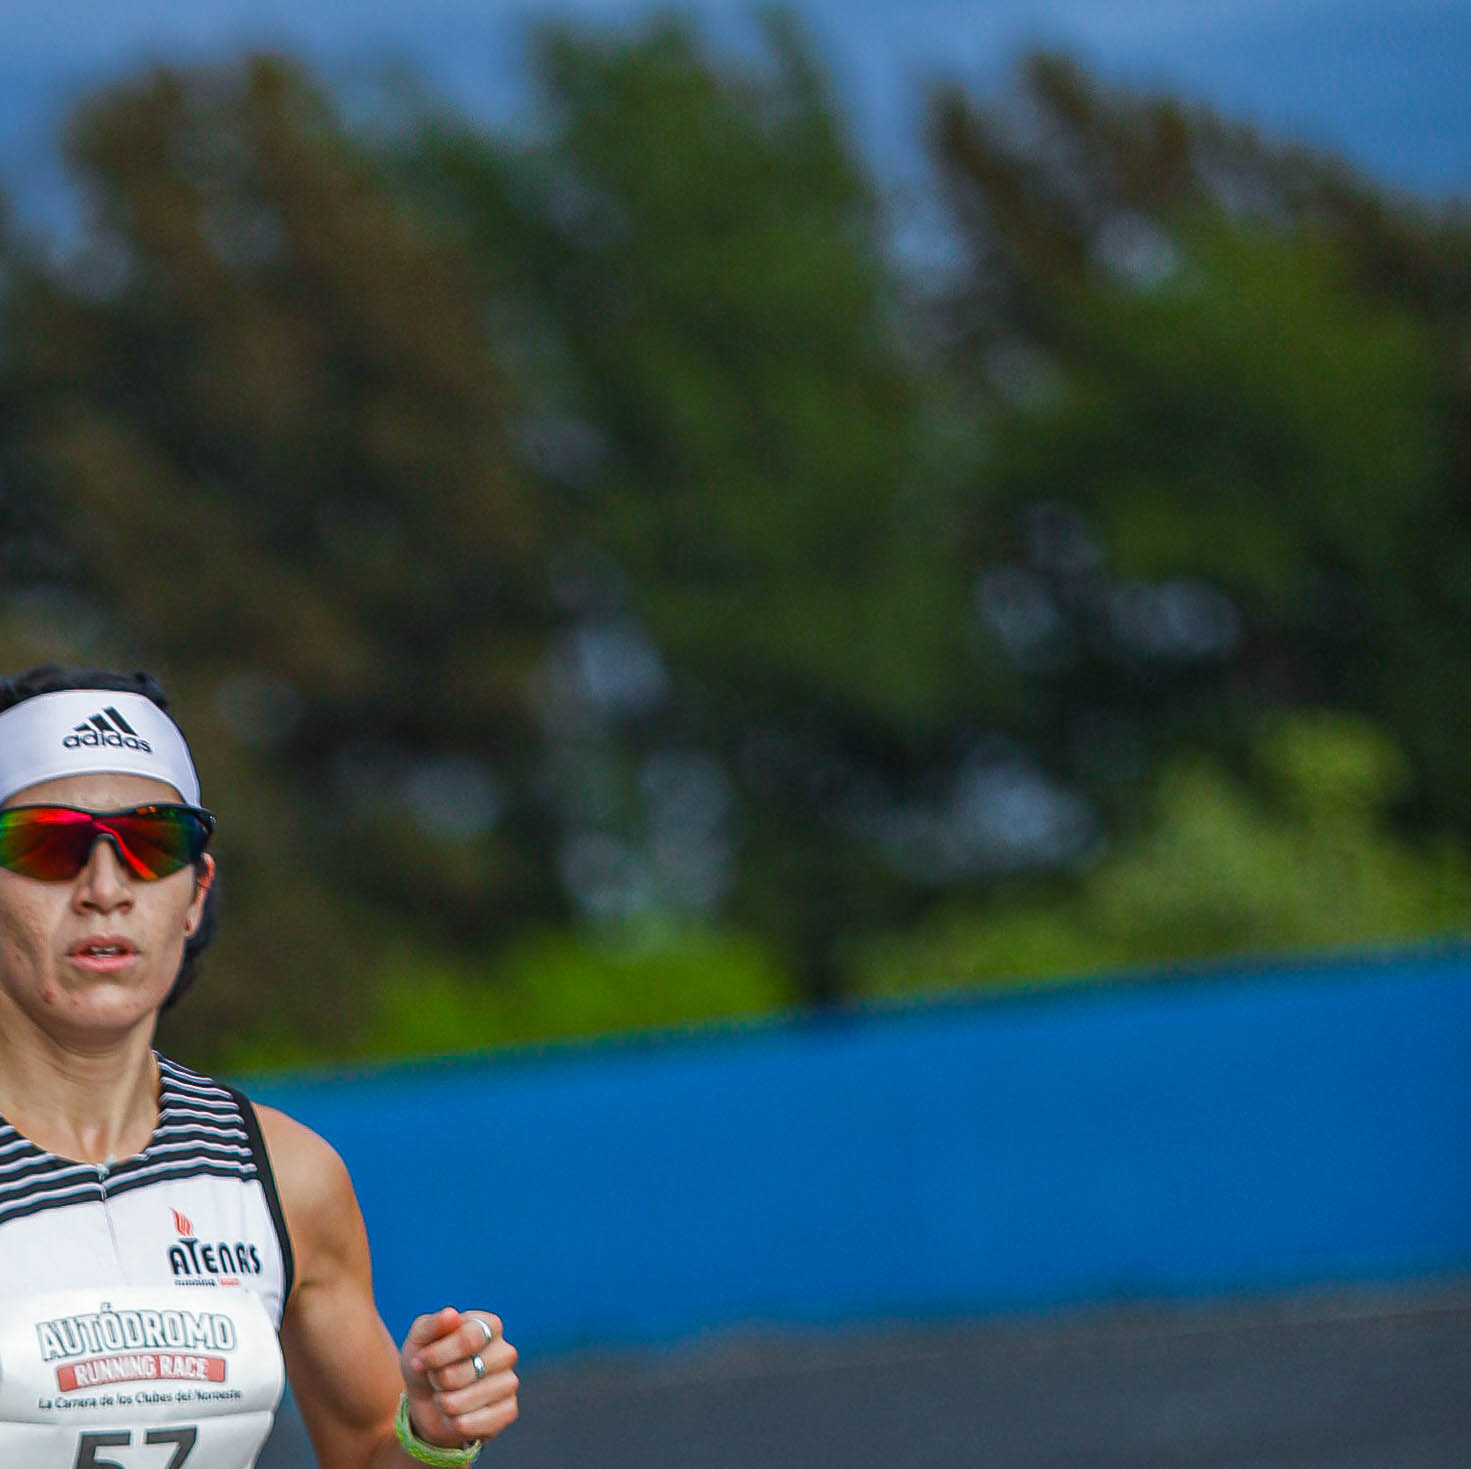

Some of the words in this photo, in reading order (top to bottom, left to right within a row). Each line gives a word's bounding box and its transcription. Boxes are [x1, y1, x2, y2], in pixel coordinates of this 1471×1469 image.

[62, 729, 152, 752] adidas
[168, 1238, 261, 1275] ATENAS
[36, 1302, 237, 1361] AUTÓDROMO
[74, 1355, 157, 1386] RUNNING
[159, 1353, 209, 1381] RACE
[38, 1396, 52, 1409] La
